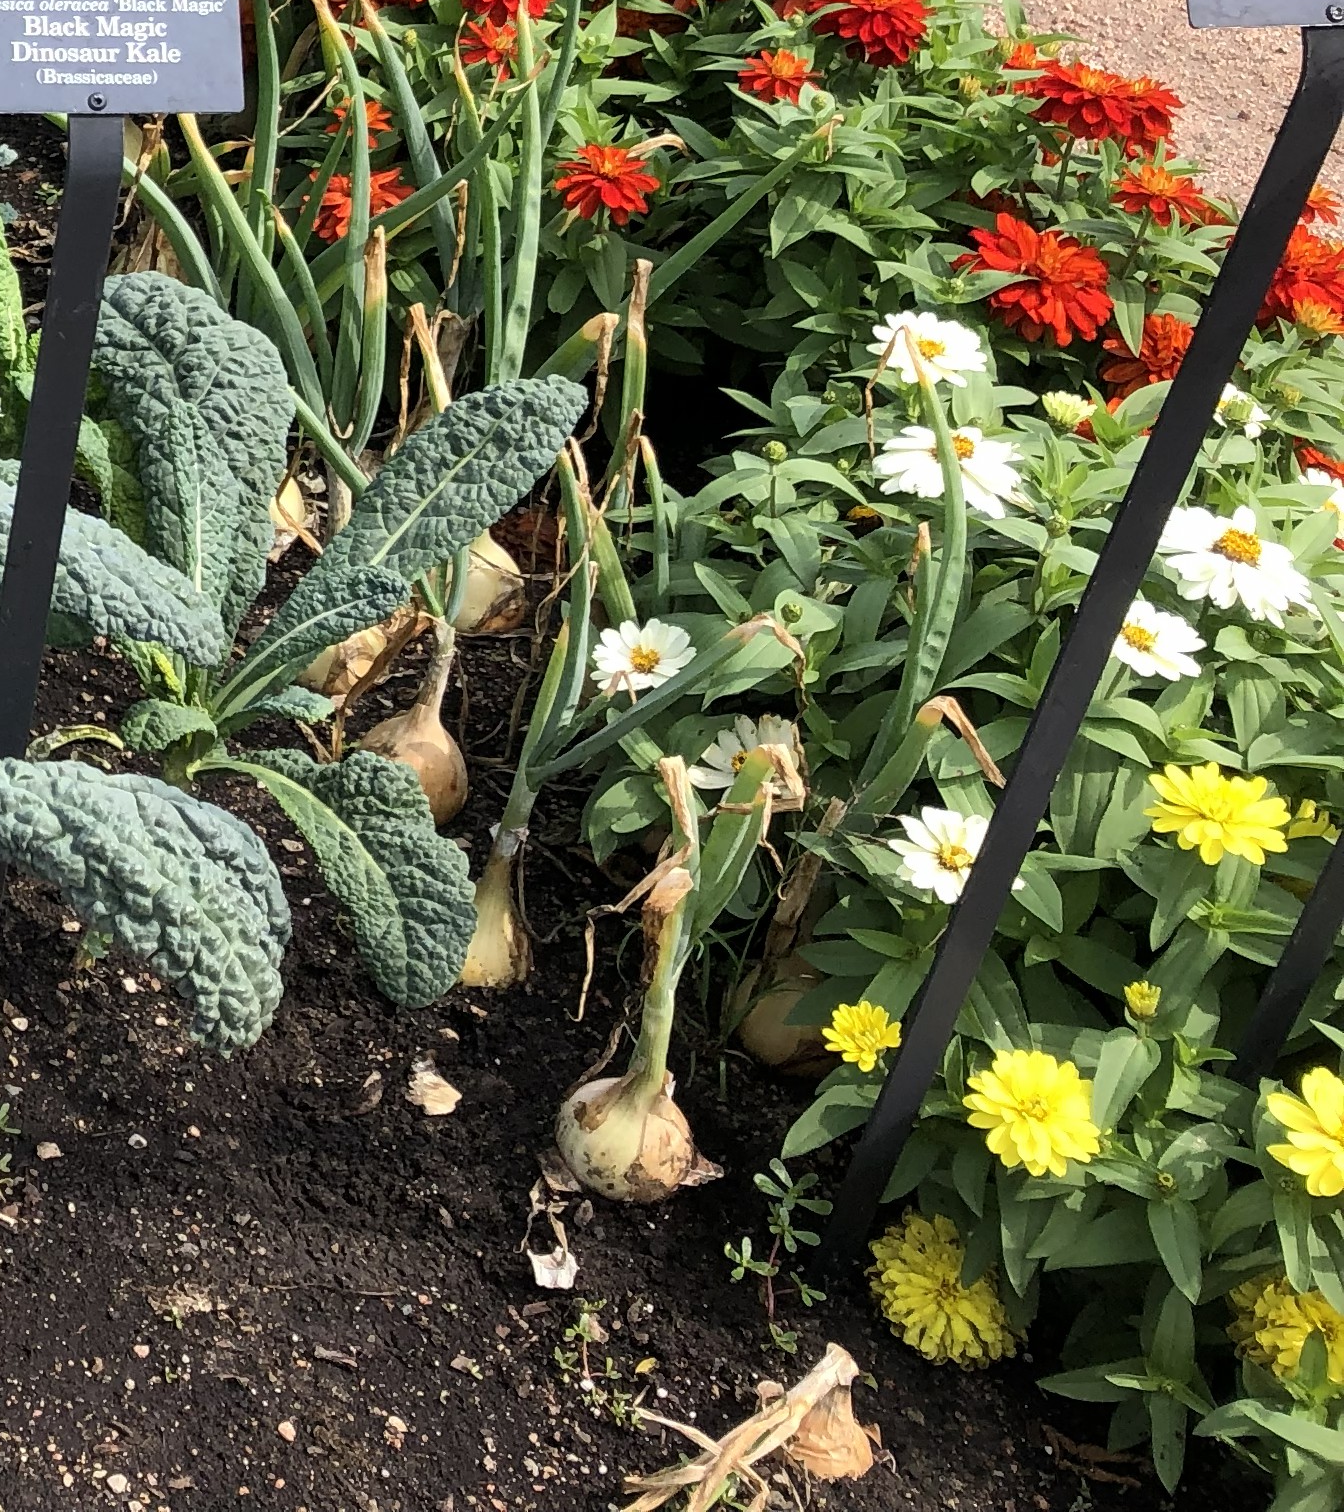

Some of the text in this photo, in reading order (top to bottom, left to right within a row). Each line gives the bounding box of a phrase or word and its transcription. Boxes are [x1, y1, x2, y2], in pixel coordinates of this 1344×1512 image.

[23, 15, 168, 41] Black Magic
[10, 41, 182, 63] Dinosaur Kale
[35, 68, 158, 85] (Brassicaceae)
